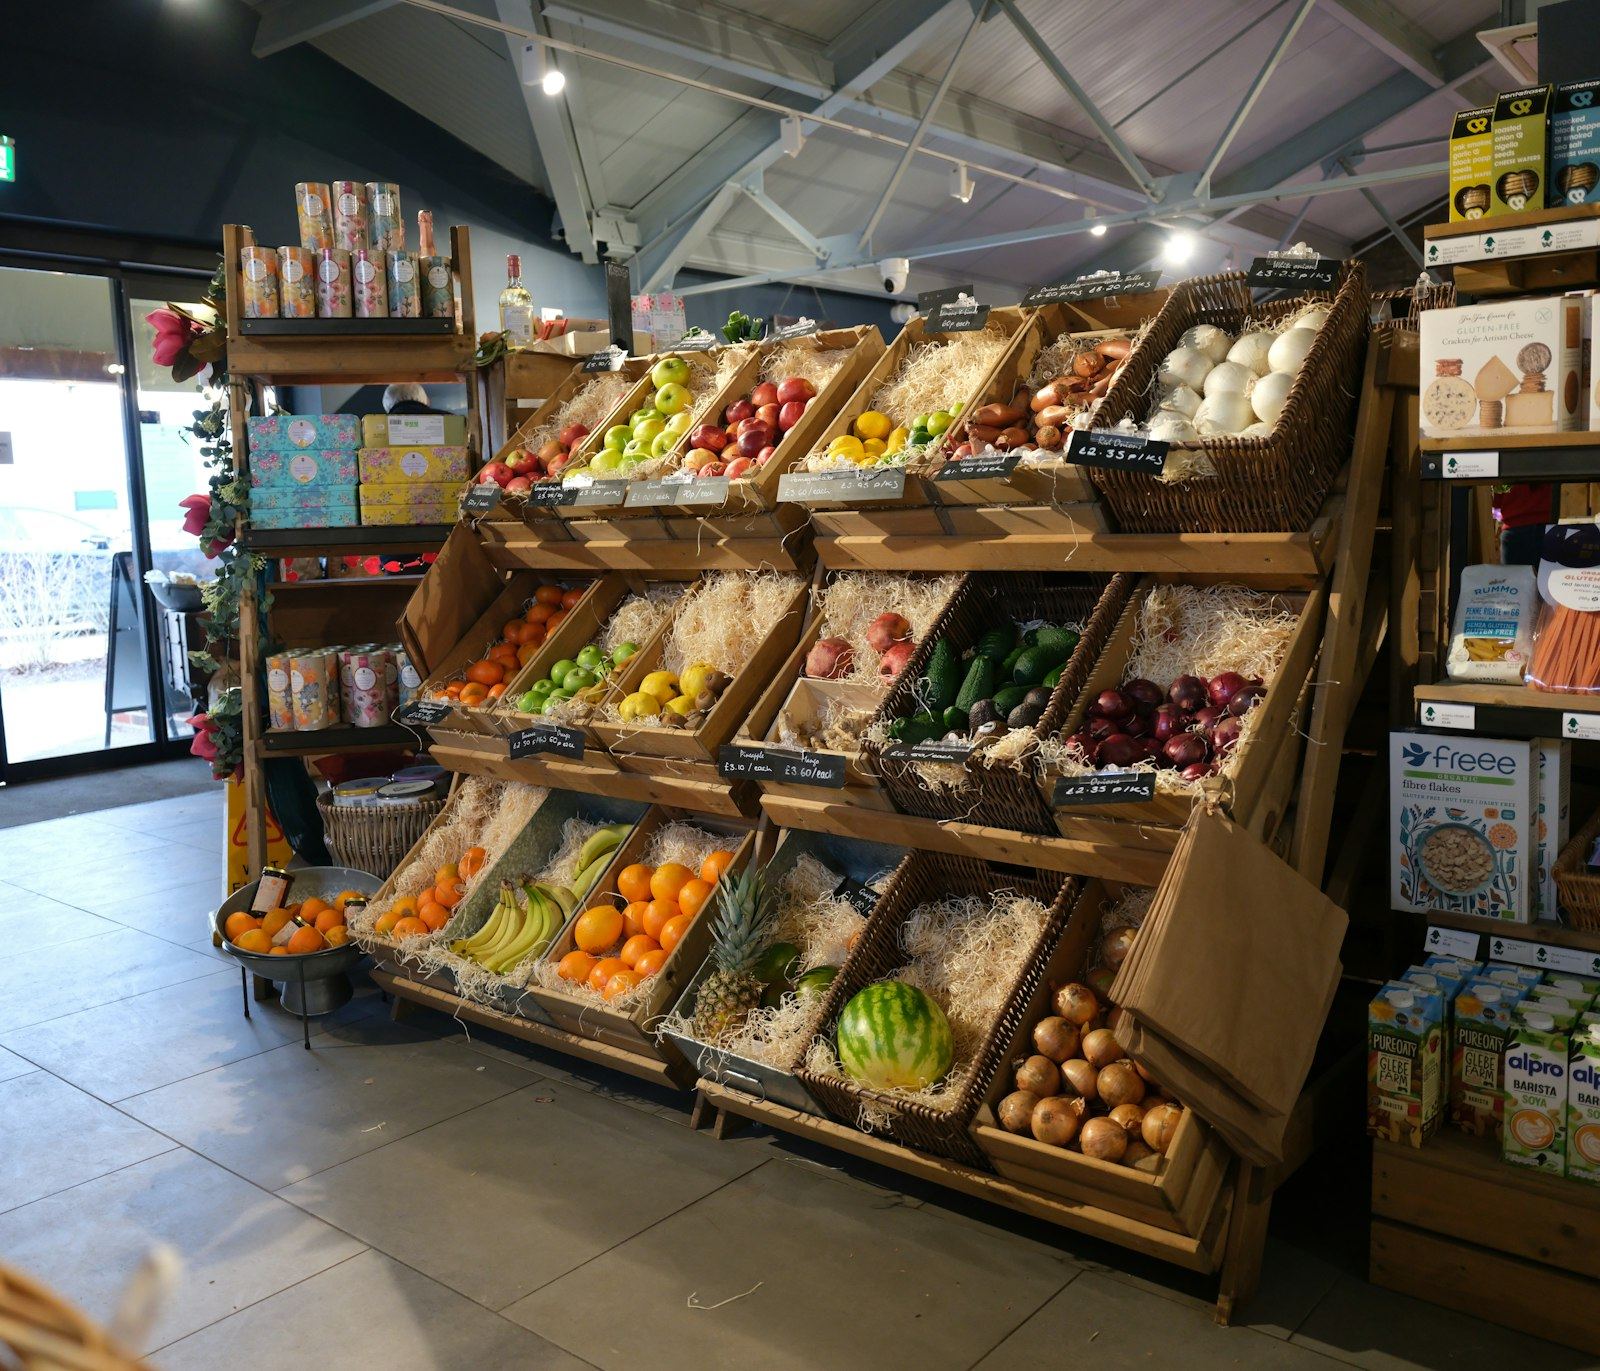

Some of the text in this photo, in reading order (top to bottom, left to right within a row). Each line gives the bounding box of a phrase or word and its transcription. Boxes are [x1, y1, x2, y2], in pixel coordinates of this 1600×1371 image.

[1554, 115, 1586, 127] cracked
[1554, 121, 1600, 135] black peppe
[1494, 124, 1522, 135] roasted
[1564, 130, 1593, 141] smoked
[1494, 134, 1515, 143] onion
[1569, 140, 1583, 149] salt
[1494, 149, 1515, 159] seeds
[1494, 154, 1541, 168] CHEESE WAFERS
[1554, 150, 1577, 159] CHEESE
[1442, 336, 1471, 346] Crackers
[1483, 334, 1508, 342] Artisan
[1509, 332, 1535, 340] Cheese
[1113, 438, 1142, 450] Onions
[1474, 585, 1519, 596] RUMMO
[1433, 745, 1517, 775] freee
[1437, 773, 1479, 783] ORGANIC
[1402, 779, 1462, 794] fibre flakes
[1402, 792, 1425, 800] GLUTEN
[1459, 797, 1474, 805] FREE
[1373, 1033, 1418, 1058] PUREOATY
[1458, 1028, 1504, 1053] PUREOATY
[1379, 1056, 1410, 1076] GLEBE
[1464, 1051, 1496, 1071] GLEBE
[1508, 1052, 1564, 1077] alpro
[1379, 1070, 1408, 1087] FARM
[1464, 1065, 1495, 1082] FARM
[1572, 1065, 1600, 1090] alp
[1513, 1079, 1557, 1097] BARISTA
[1522, 1094, 1547, 1108] SOYA
[1578, 1092, 1600, 1106] BAR
